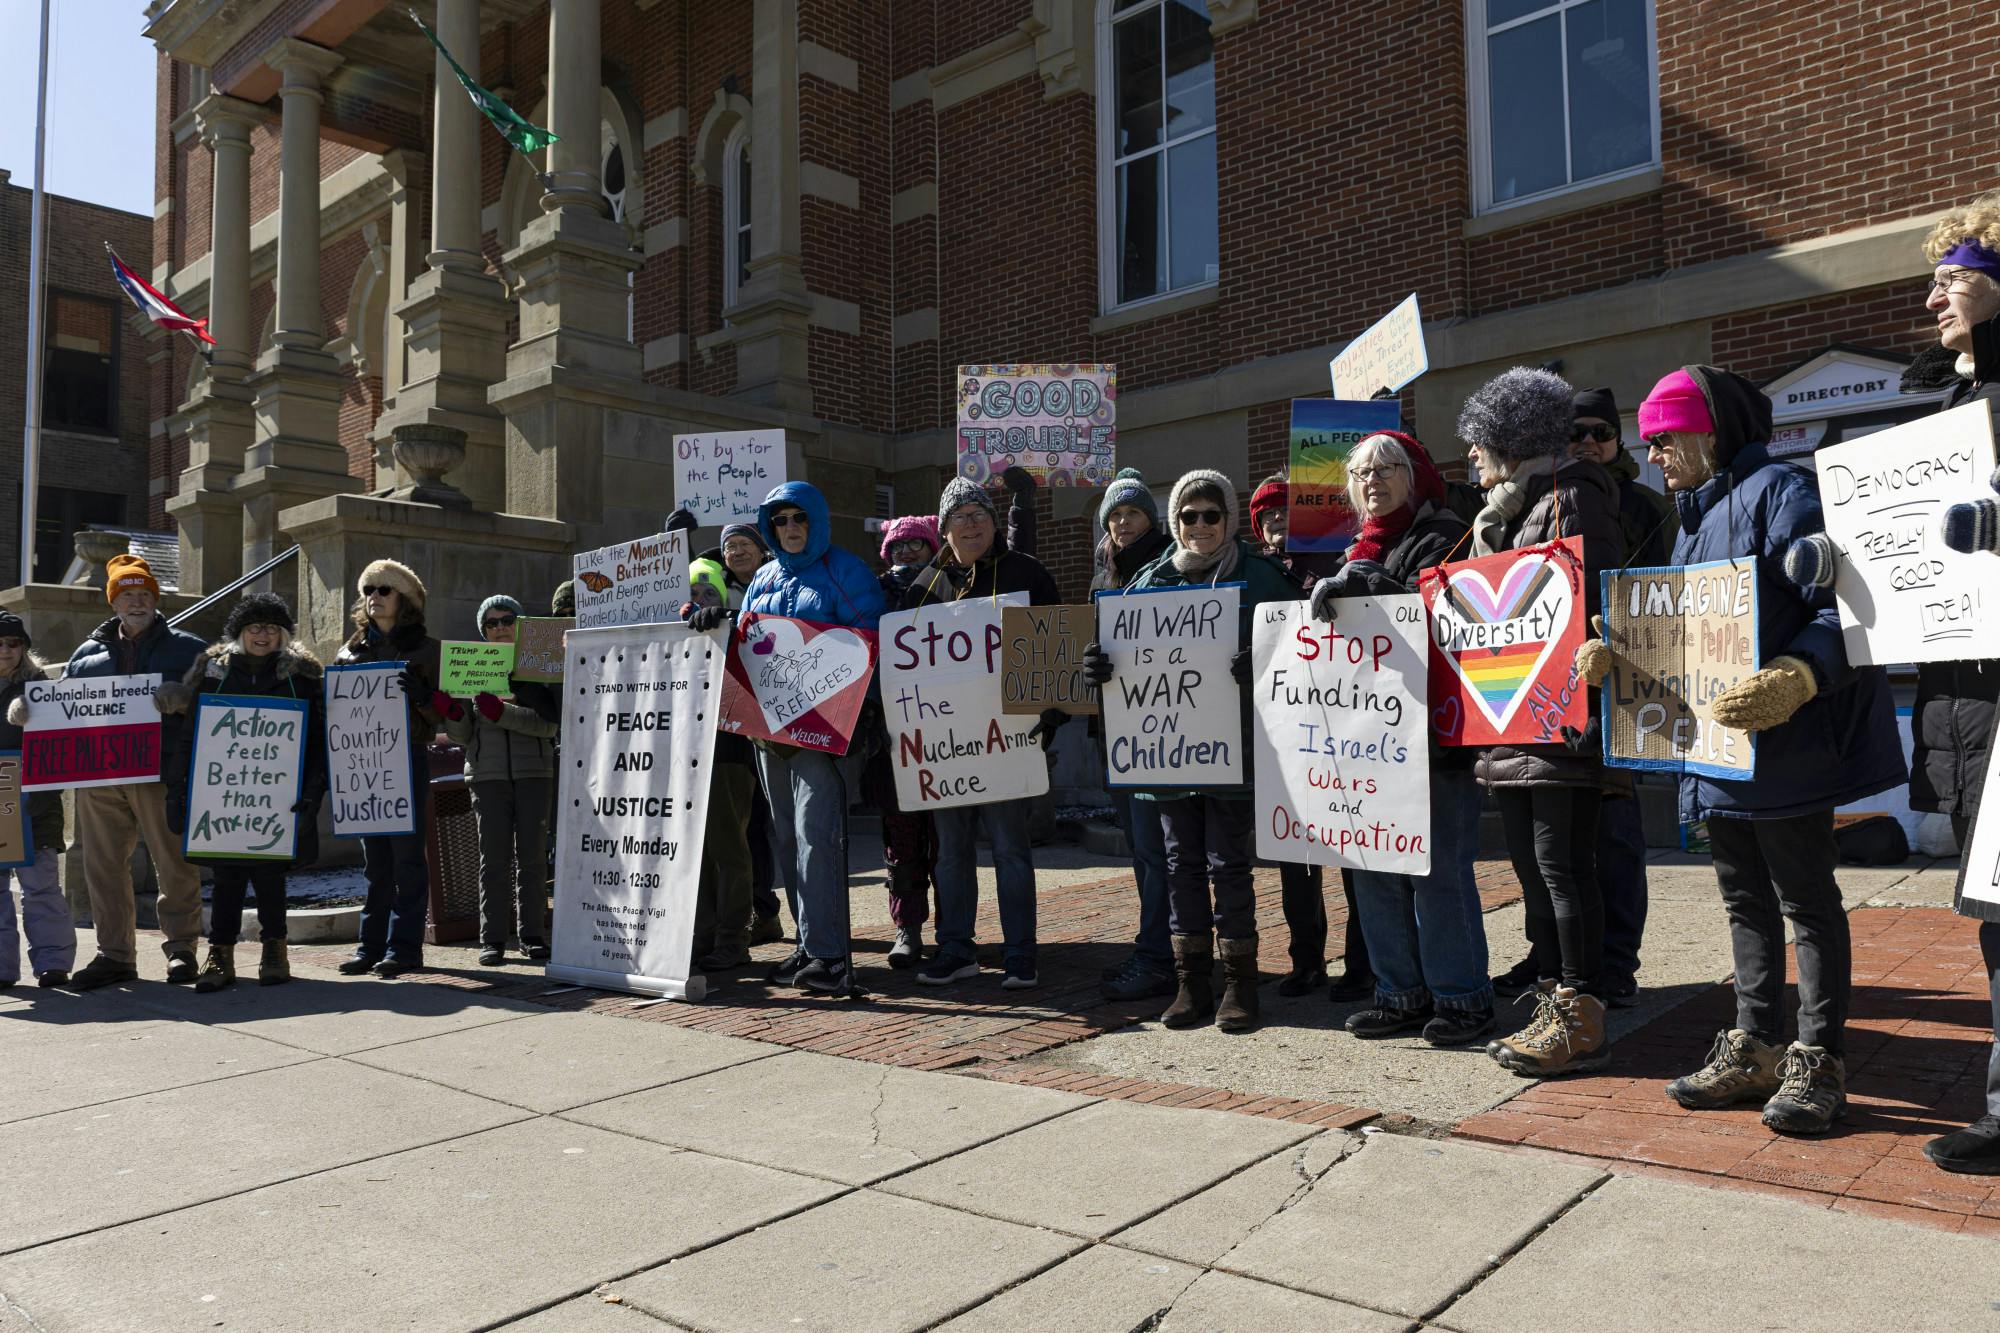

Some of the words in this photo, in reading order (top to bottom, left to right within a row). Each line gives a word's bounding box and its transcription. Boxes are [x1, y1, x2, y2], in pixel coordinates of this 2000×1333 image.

[981, 379, 1101, 418] GOOD
[1788, 379, 1887, 404] DIRECTORY
[960, 425, 1113, 455] TROUBLE
[1300, 434, 1327, 450] ALL
[1332, 432, 1368, 443] PEO
[1772, 429, 1799, 443] ICE
[678, 438, 704, 461] Of,
[714, 439, 733, 465] by
[687, 468, 709, 483] the
[718, 462, 767, 485] People
[1826, 448, 1975, 506] DEMOCRACY
[704, 491, 727, 513] just
[734, 489, 748, 498] the
[1296, 494, 1324, 506] ARE
[578, 553, 604, 570] Like
[610, 547, 626, 561] the
[628, 532, 681, 563] Monarch
[1840, 543, 1853, 564] A
[1856, 524, 1925, 554] REALLY
[616, 556, 674, 581] Butterfly
[1890, 560, 1944, 590] GOOD
[577, 590, 613, 610] Human
[616, 582, 650, 600] Beings
[653, 575, 682, 592] cross
[1628, 569, 1750, 618] IMAGINE
[580, 607, 617, 628] Borders
[620, 603, 629, 622] to
[1113, 608, 1142, 640] All
[1153, 599, 1222, 640] WAR
[1921, 587, 1982, 631] IDEA!
[746, 624, 767, 641] WE
[1026, 608, 1072, 637] WE
[450, 647, 479, 655] TRUMP
[1010, 638, 1084, 669] SHAL
[1134, 646, 1154, 666] is
[1168, 647, 1187, 665] a
[29, 683, 107, 703] Colonialism
[112, 680, 157, 698] breeds
[334, 674, 401, 700] LOVE
[594, 683, 623, 694] STAND
[627, 682, 650, 693] WITH
[653, 681, 667, 691] US
[670, 680, 688, 691] FOR
[774, 663, 852, 722] REFUGEES
[1004, 669, 1098, 704] OVERCOM
[1119, 670, 1201, 710] WAR
[1271, 669, 1403, 726] Funding
[61, 702, 126, 720] VIOLENCE
[896, 684, 954, 723] the
[211, 708, 294, 741] Action
[606, 711, 671, 732] PEACE
[1142, 712, 1179, 734] ON
[1636, 702, 1736, 764] PEACE
[329, 721, 400, 753] Country
[790, 727, 832, 748] WELCOME
[900, 728, 984, 768] Nuclear
[986, 718, 1037, 754] Arms
[1299, 723, 1408, 764] Israel's
[27, 736, 70, 778] FREE
[226, 742, 279, 760] feels
[613, 751, 654, 772] AND
[1111, 734, 1230, 773] Children
[207, 761, 287, 786] Better
[336, 771, 395, 793] LOVE
[918, 768, 987, 801] Race
[222, 790, 272, 808] than
[335, 793, 409, 824] Justice
[593, 797, 673, 818] JUSTICE
[1329, 799, 1363, 818] and
[192, 810, 285, 850] Anxiety
[1273, 805, 1426, 855] Occupation
[581, 834, 618, 858] Every
[622, 835, 678, 861] Monday
[592, 870, 620, 886] 11:30
[629, 872, 660, 889] 12:30
[582, 902, 595, 912] The
[597, 904, 621, 914] Athens
[623, 906, 645, 915] Peace
[648, 907, 666, 919] Vigil
[596, 918, 609, 927] has
[611, 920, 628, 929] been
[629, 922, 646, 931] held
[604, 934, 616, 943] this
[618, 937, 632, 945] spot
[635, 937, 647, 947] for
[602, 949, 610, 957] 40
[611, 952, 633, 960] years.
